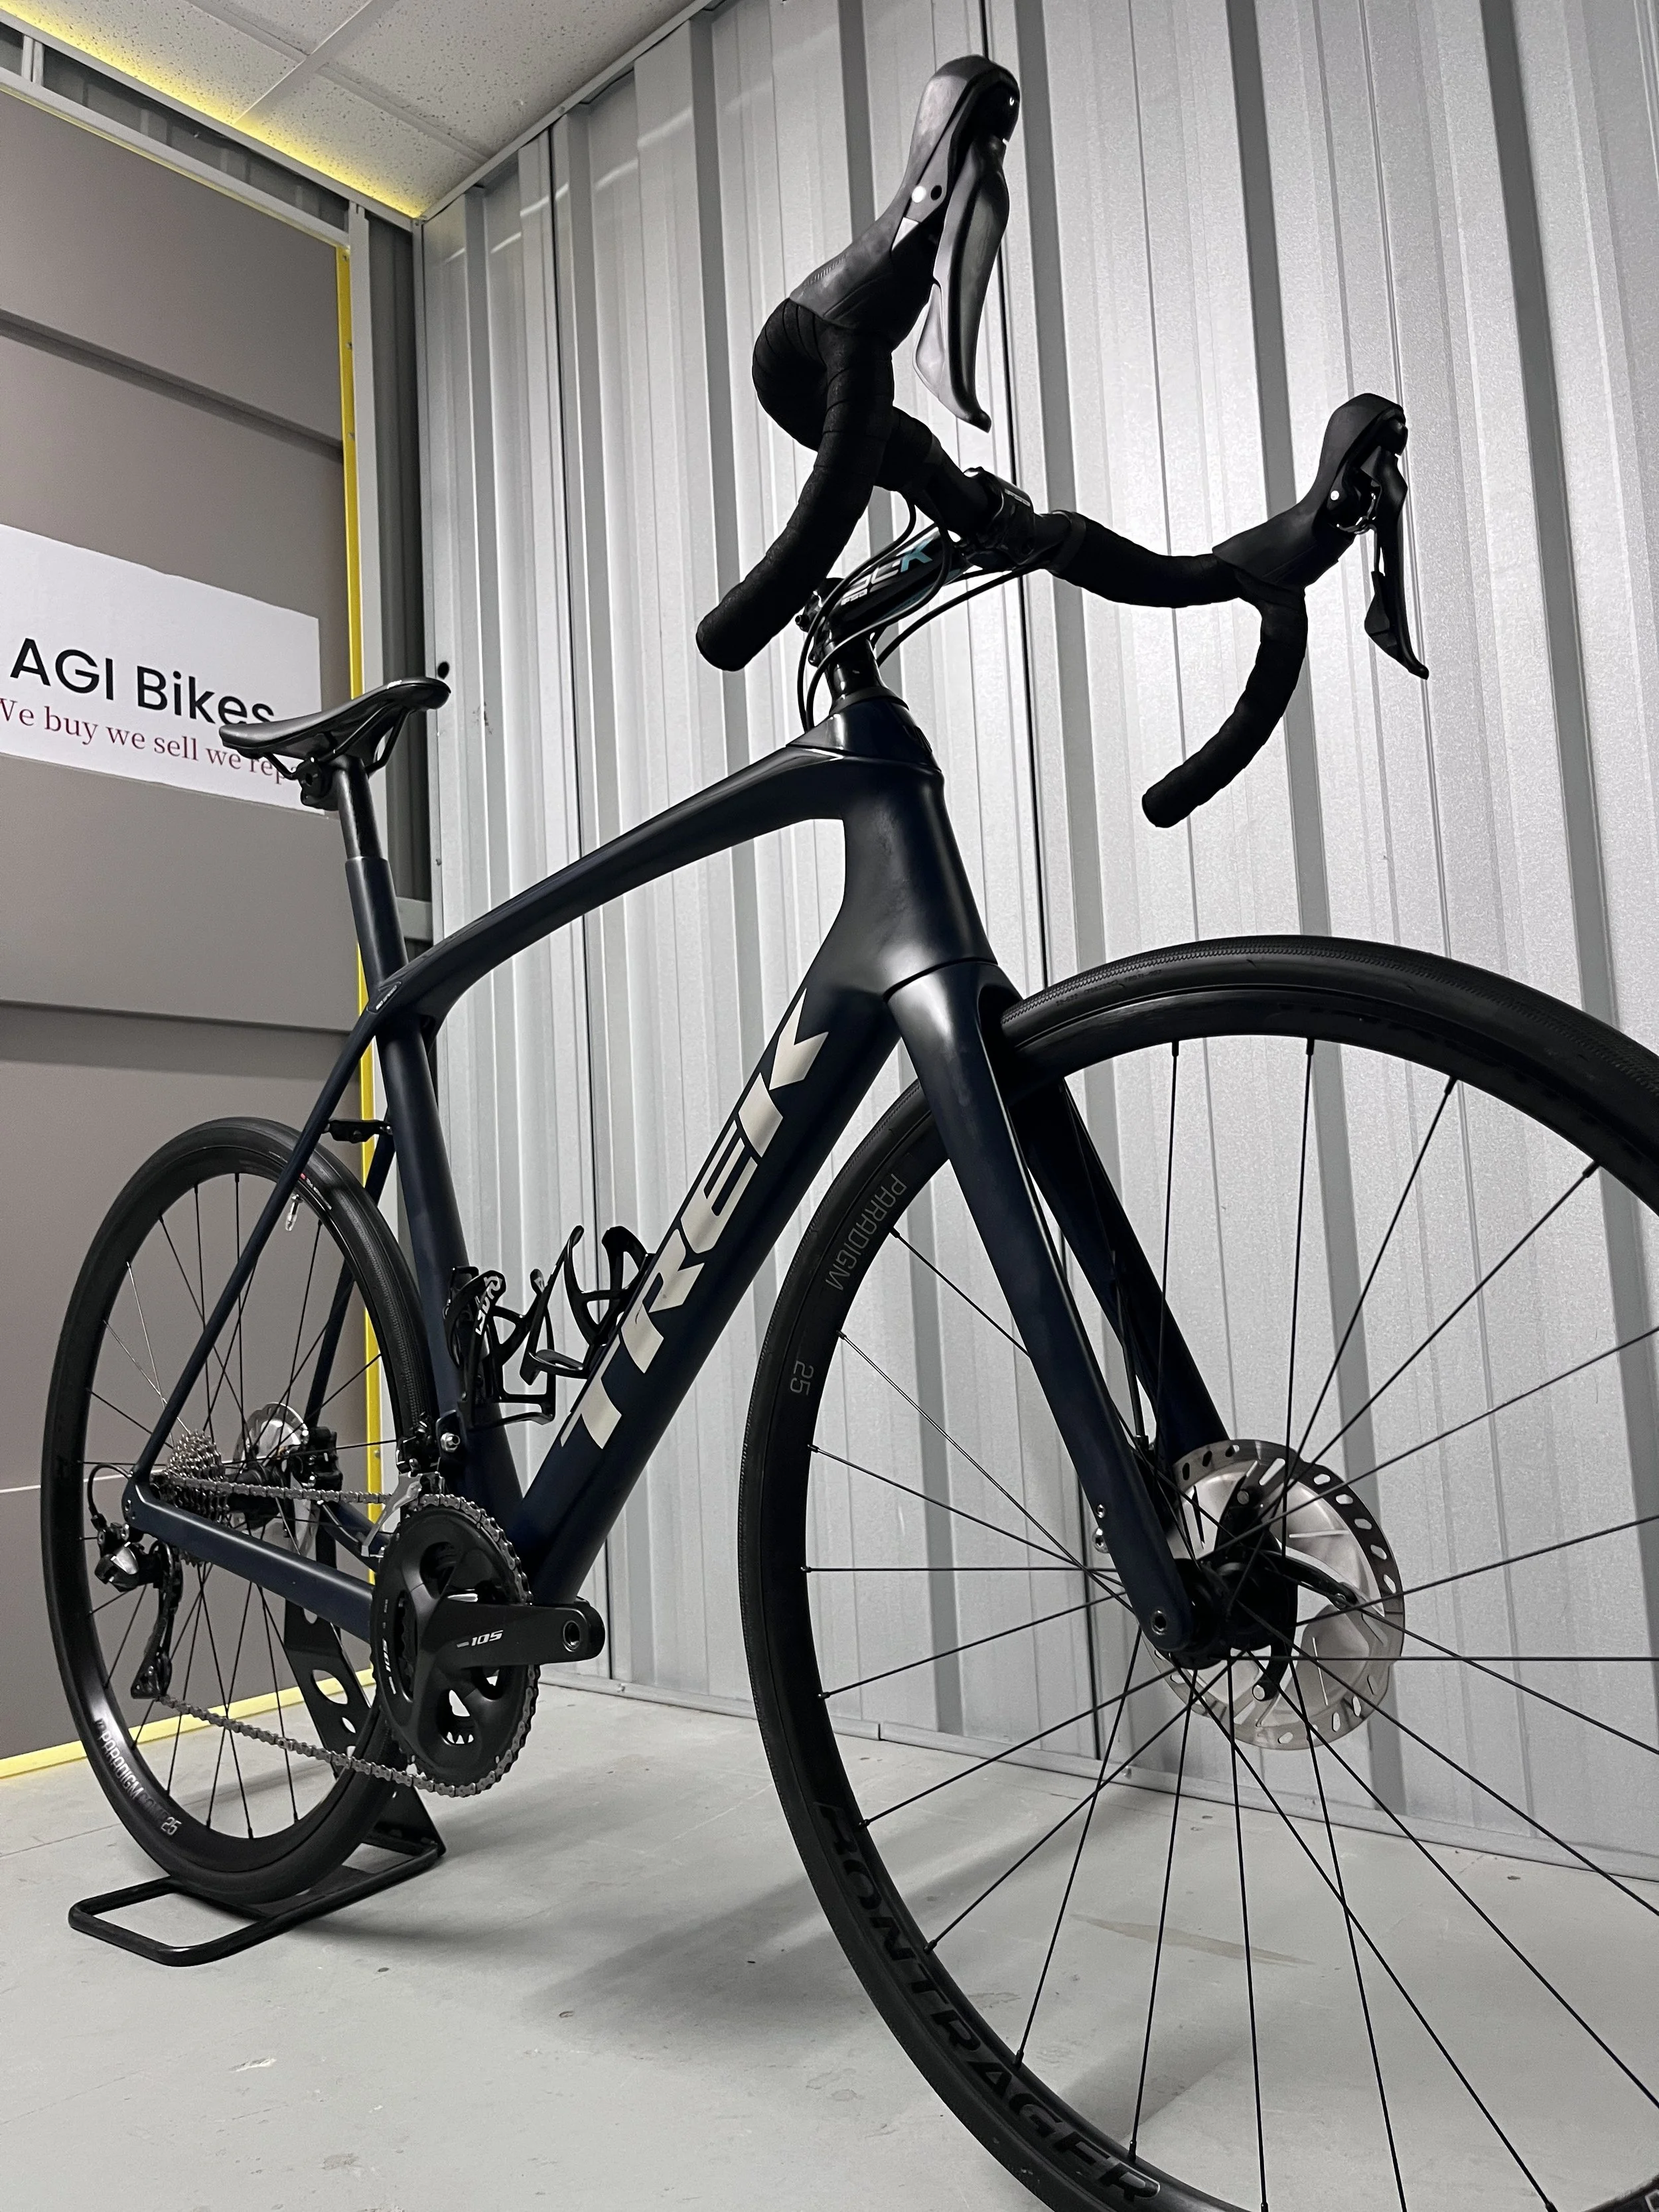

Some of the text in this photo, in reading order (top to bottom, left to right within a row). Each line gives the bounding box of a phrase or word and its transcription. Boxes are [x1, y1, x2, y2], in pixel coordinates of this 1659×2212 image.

[10, 638, 275, 725] AGI Bikes
[44, 705, 98, 745] buy
[106, 727, 145, 750] we
[154, 735, 198, 761] sell
[205, 747, 242, 770] we
[560, 989, 829, 1449] TREK
[790, 1173, 908, 1396] PARADIGM 25
[471, 1629, 504, 1647] 105
[98, 1732, 145, 1800] PARADIGM
[160, 1816, 182, 1836] 25
